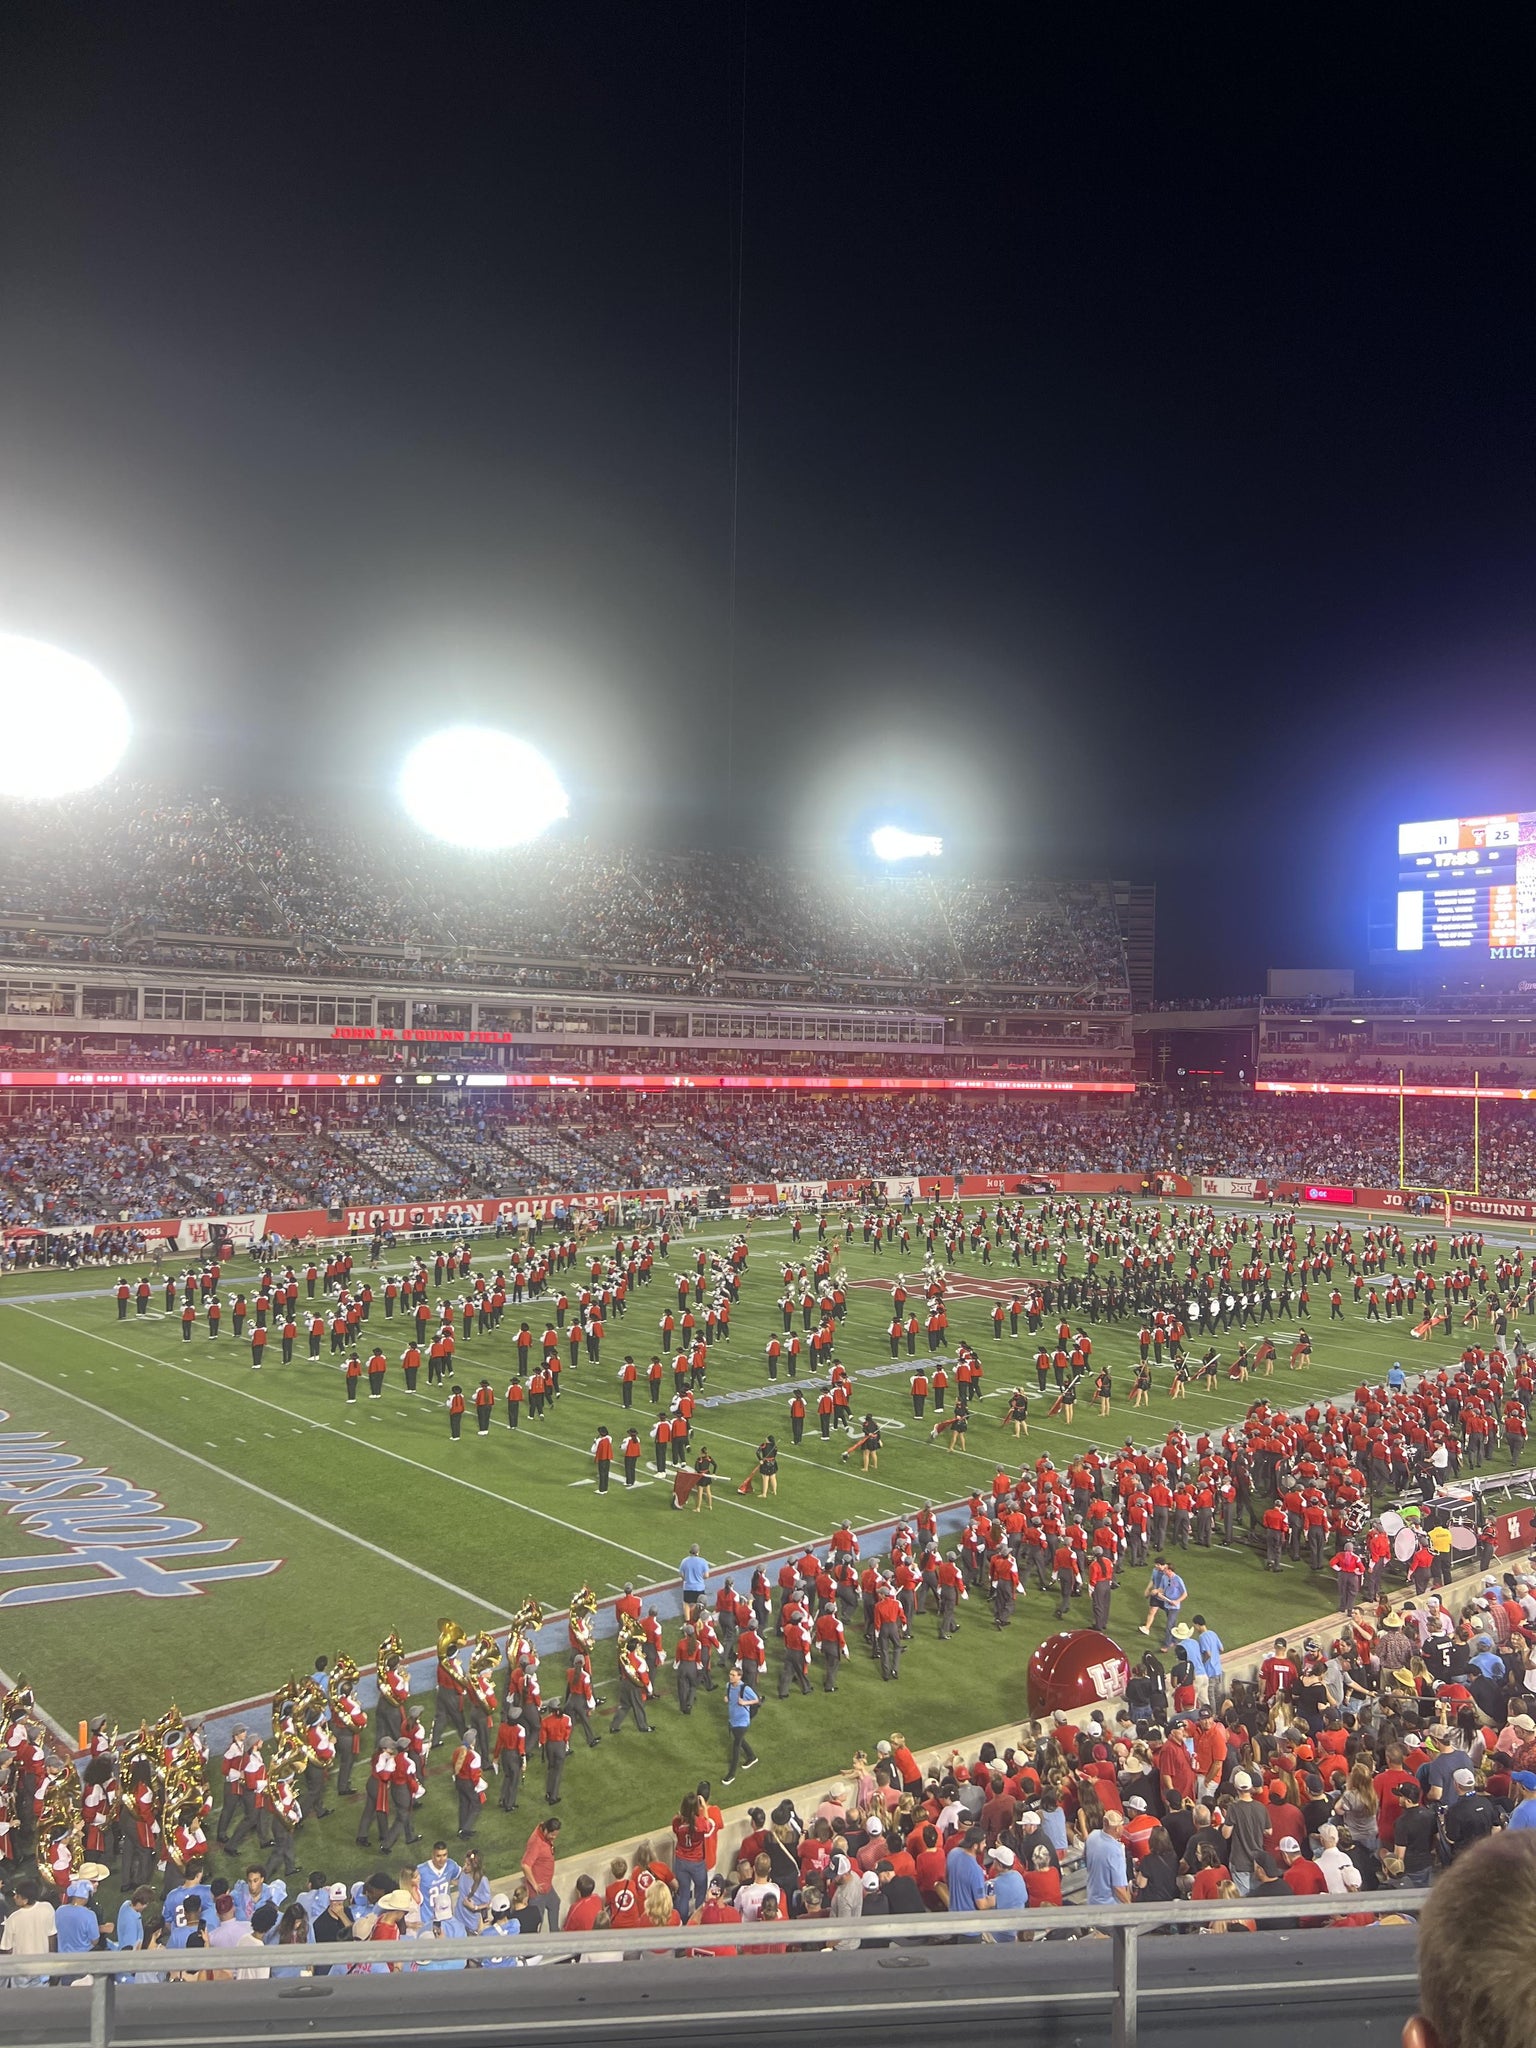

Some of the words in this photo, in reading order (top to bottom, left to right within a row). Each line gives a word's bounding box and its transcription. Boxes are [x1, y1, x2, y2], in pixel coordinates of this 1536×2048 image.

[1438, 836, 1447, 845] 11
[1495, 831, 1510, 840] 25
[332, 1027, 376, 1039] JOHN
[380, 1028, 398, 1040] M.
[402, 1029, 464, 1042] O'QUINN
[469, 1031, 512, 1043] FIELD
[347, 1204, 484, 1230] HOUSTON
[1454, 1200, 1526, 1217] O'QUINN
[1442, 1649, 1451, 1667] 5
[1278, 1672, 1284, 1690] 1
